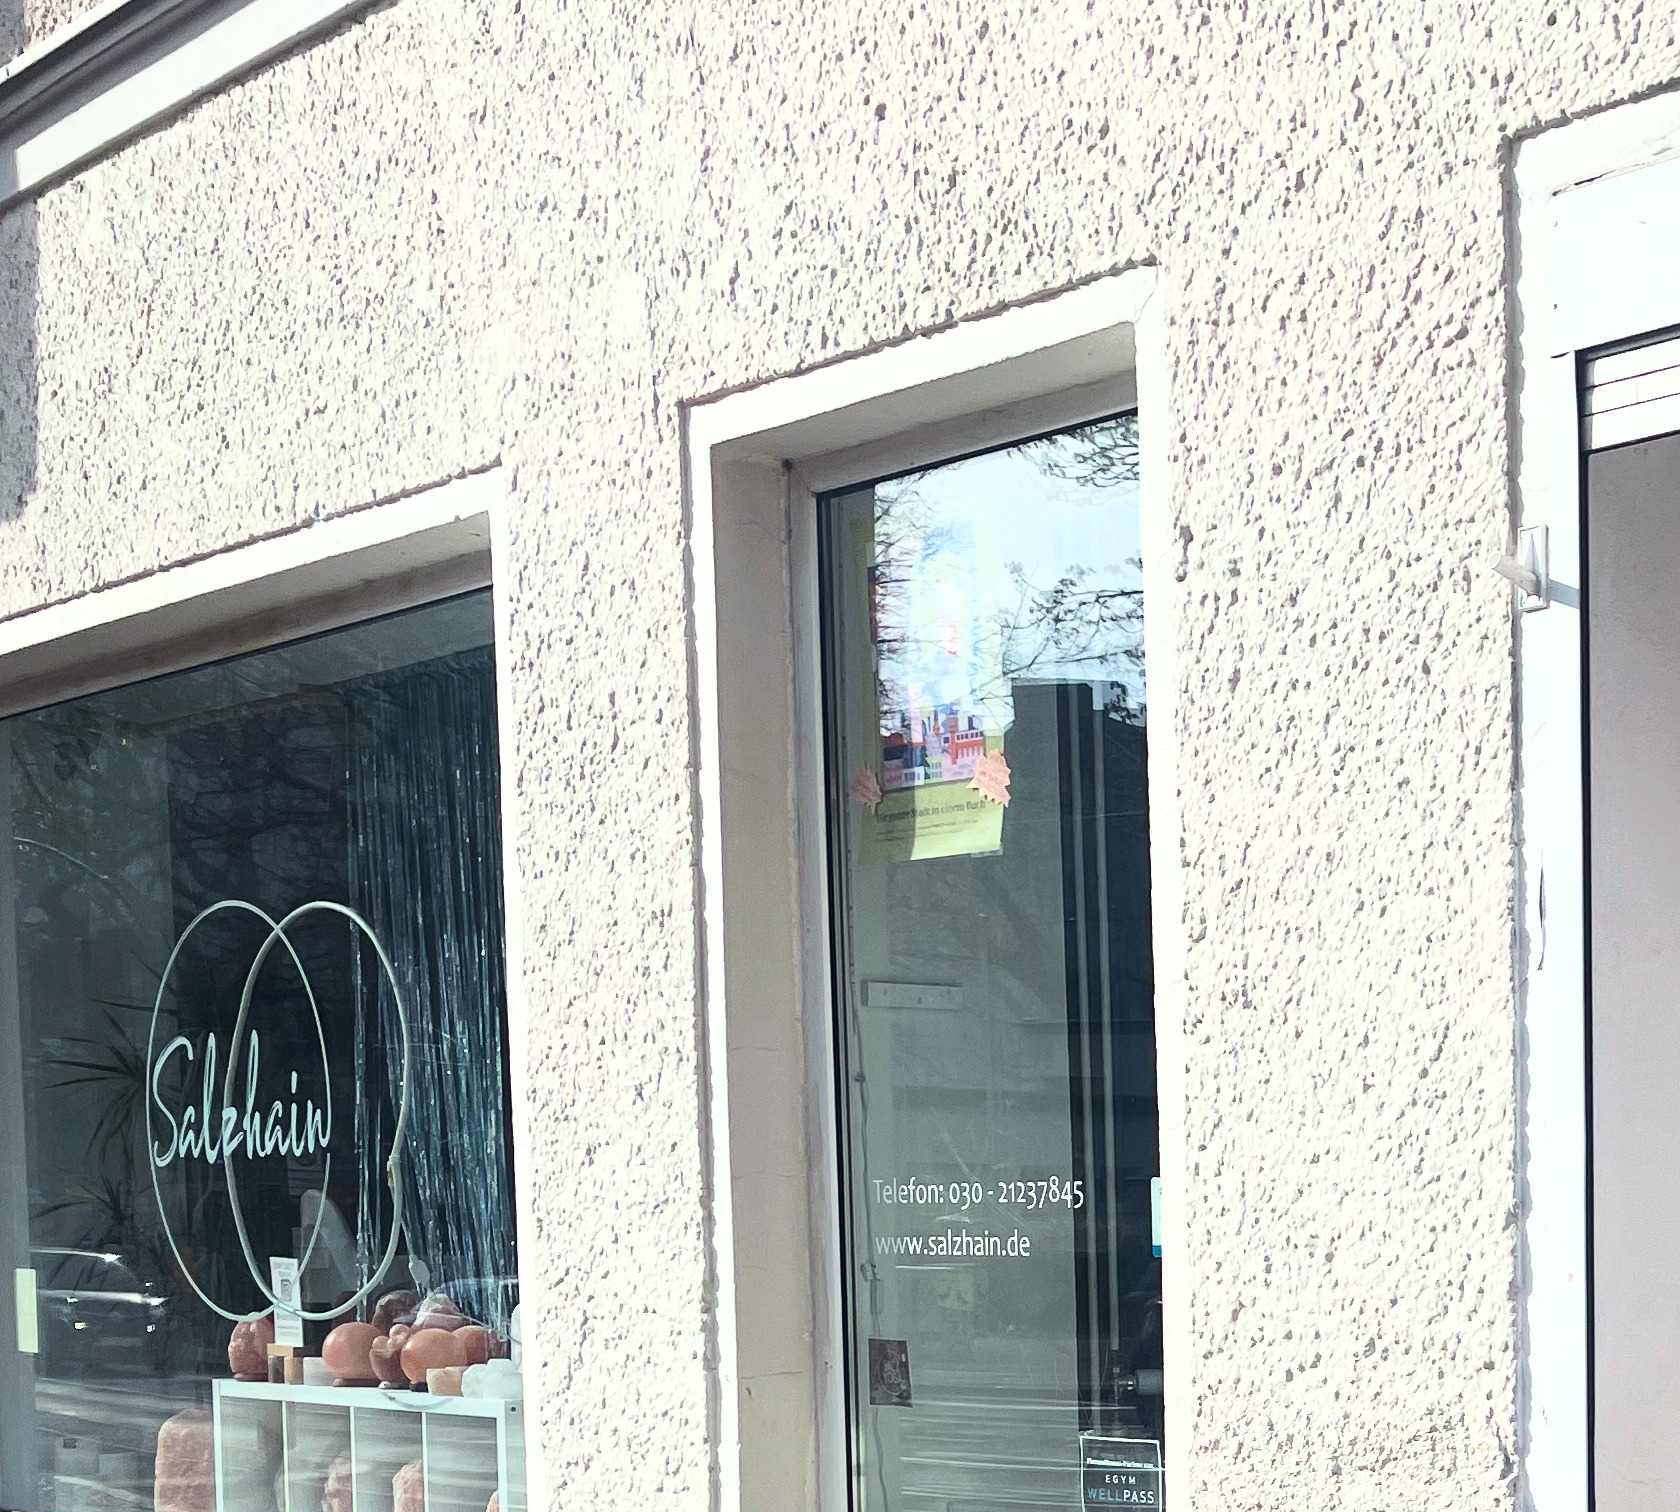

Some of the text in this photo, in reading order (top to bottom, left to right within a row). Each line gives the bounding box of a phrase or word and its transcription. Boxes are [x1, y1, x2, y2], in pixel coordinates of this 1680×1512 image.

[152, 1029, 331, 1168] Salzhain
[872, 1176, 944, 1204] Telefon:
[949, 1182, 983, 1210] 030
[998, 1175, 1084, 1209] 21237845
[875, 1228, 1031, 1257] www.salzhain.de
[1105, 1474, 1136, 1485] EGYM
[1087, 1487, 1155, 1504] WELLPASS
